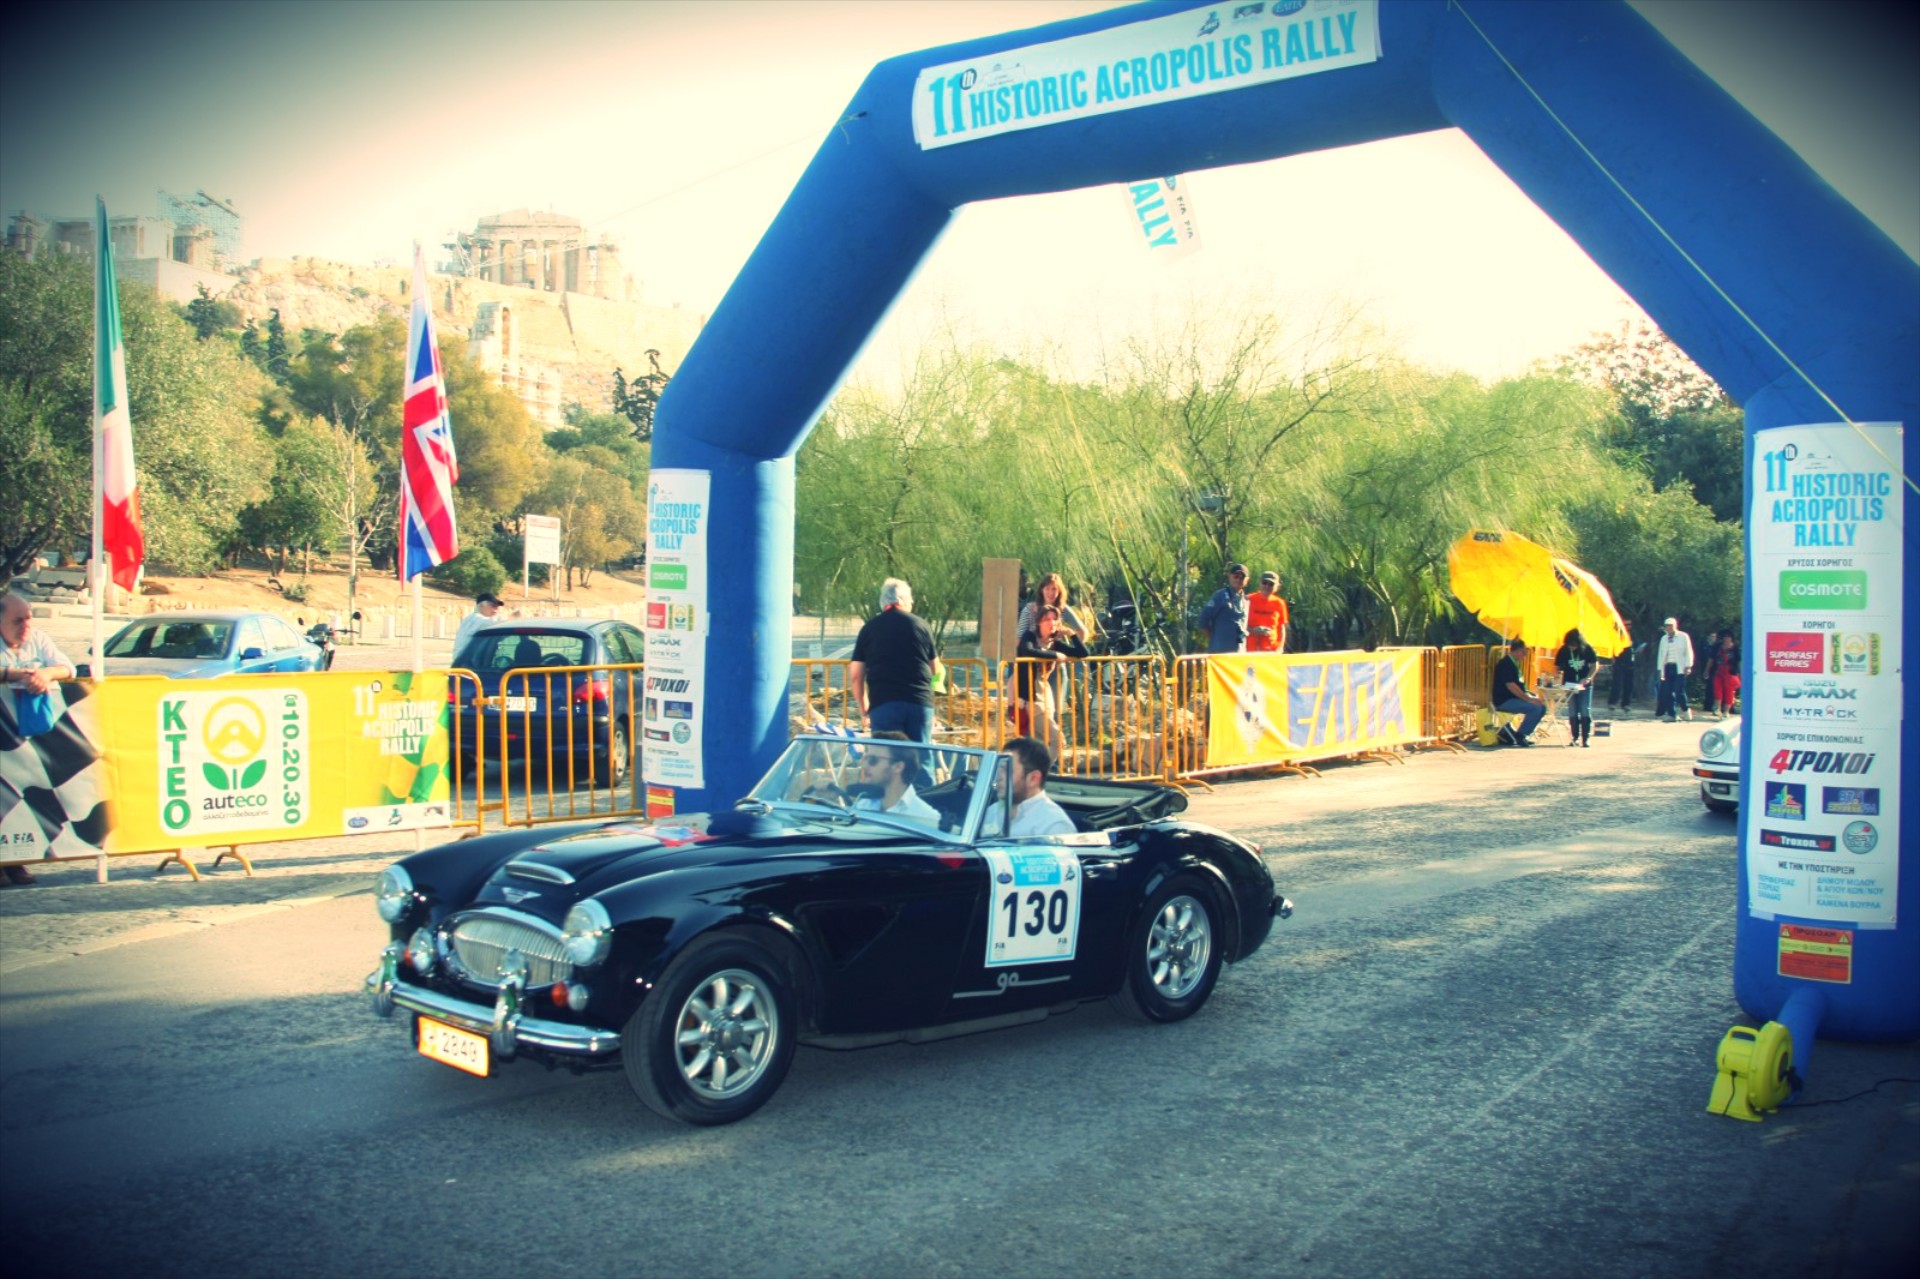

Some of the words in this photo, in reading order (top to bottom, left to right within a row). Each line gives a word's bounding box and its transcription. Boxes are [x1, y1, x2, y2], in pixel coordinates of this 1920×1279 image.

[969, 69, 1087, 129] HISTORIC
[1096, 34, 1252, 104] ACROPOLIS
[1262, 11, 1357, 69] RALLY
[1792, 473, 1891, 498] HISTORIC
[655, 503, 701, 519] HISTORIC
[1772, 497, 1883, 522] ACROPOLIS
[1795, 523, 1857, 547] RALLY
[1789, 583, 1862, 596] COSMOTE
[1769, 651, 1818, 660] SUPERFAST
[1774, 659, 1810, 668] FERRIES
[362, 718, 435, 738] ACROPOLIS
[380, 736, 422, 755] RALLY
[203, 795, 268, 810] auteco
[1003, 889, 1068, 938] 130
